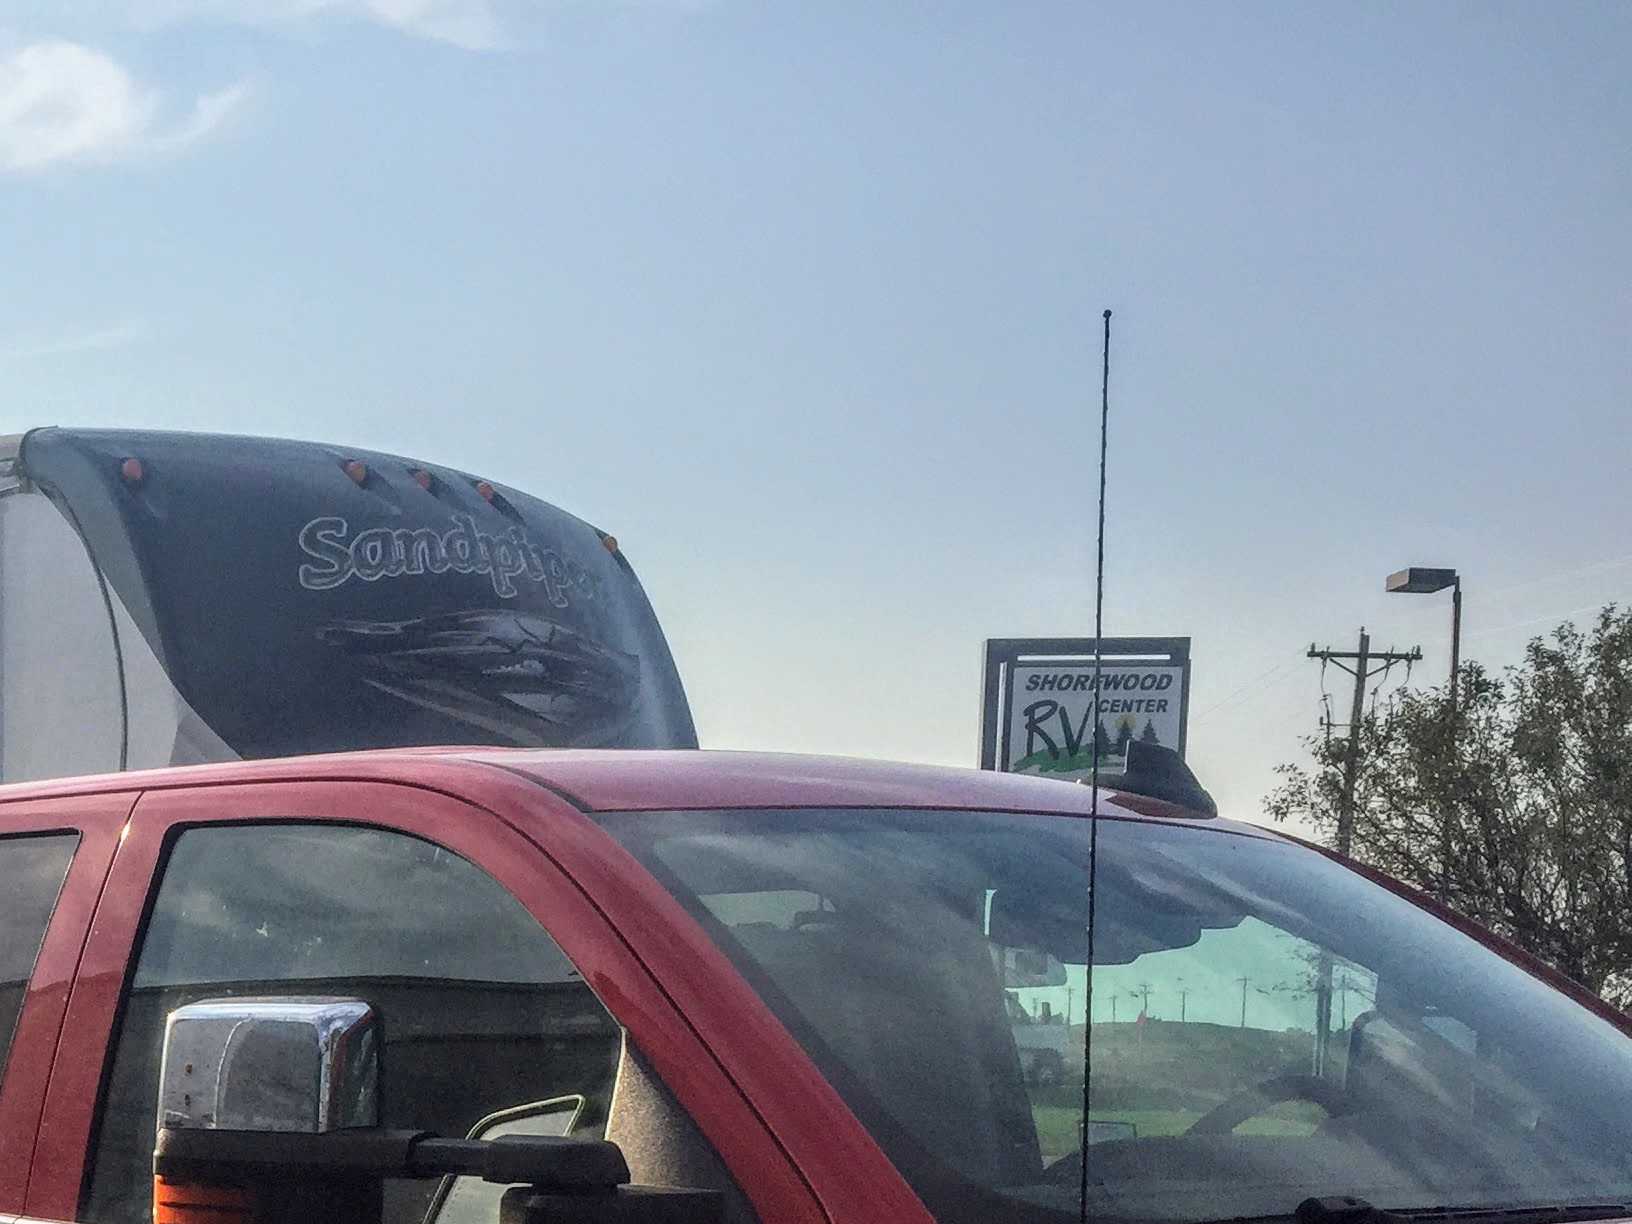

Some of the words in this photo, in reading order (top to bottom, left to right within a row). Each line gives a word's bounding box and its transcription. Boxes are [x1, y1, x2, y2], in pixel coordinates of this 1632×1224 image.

[298, 514, 602, 608] Sandpip
[1025, 674, 1172, 691] SHOREWOOD
[1099, 698, 1168, 713] CENTER
[1023, 699, 1093, 760] RV
